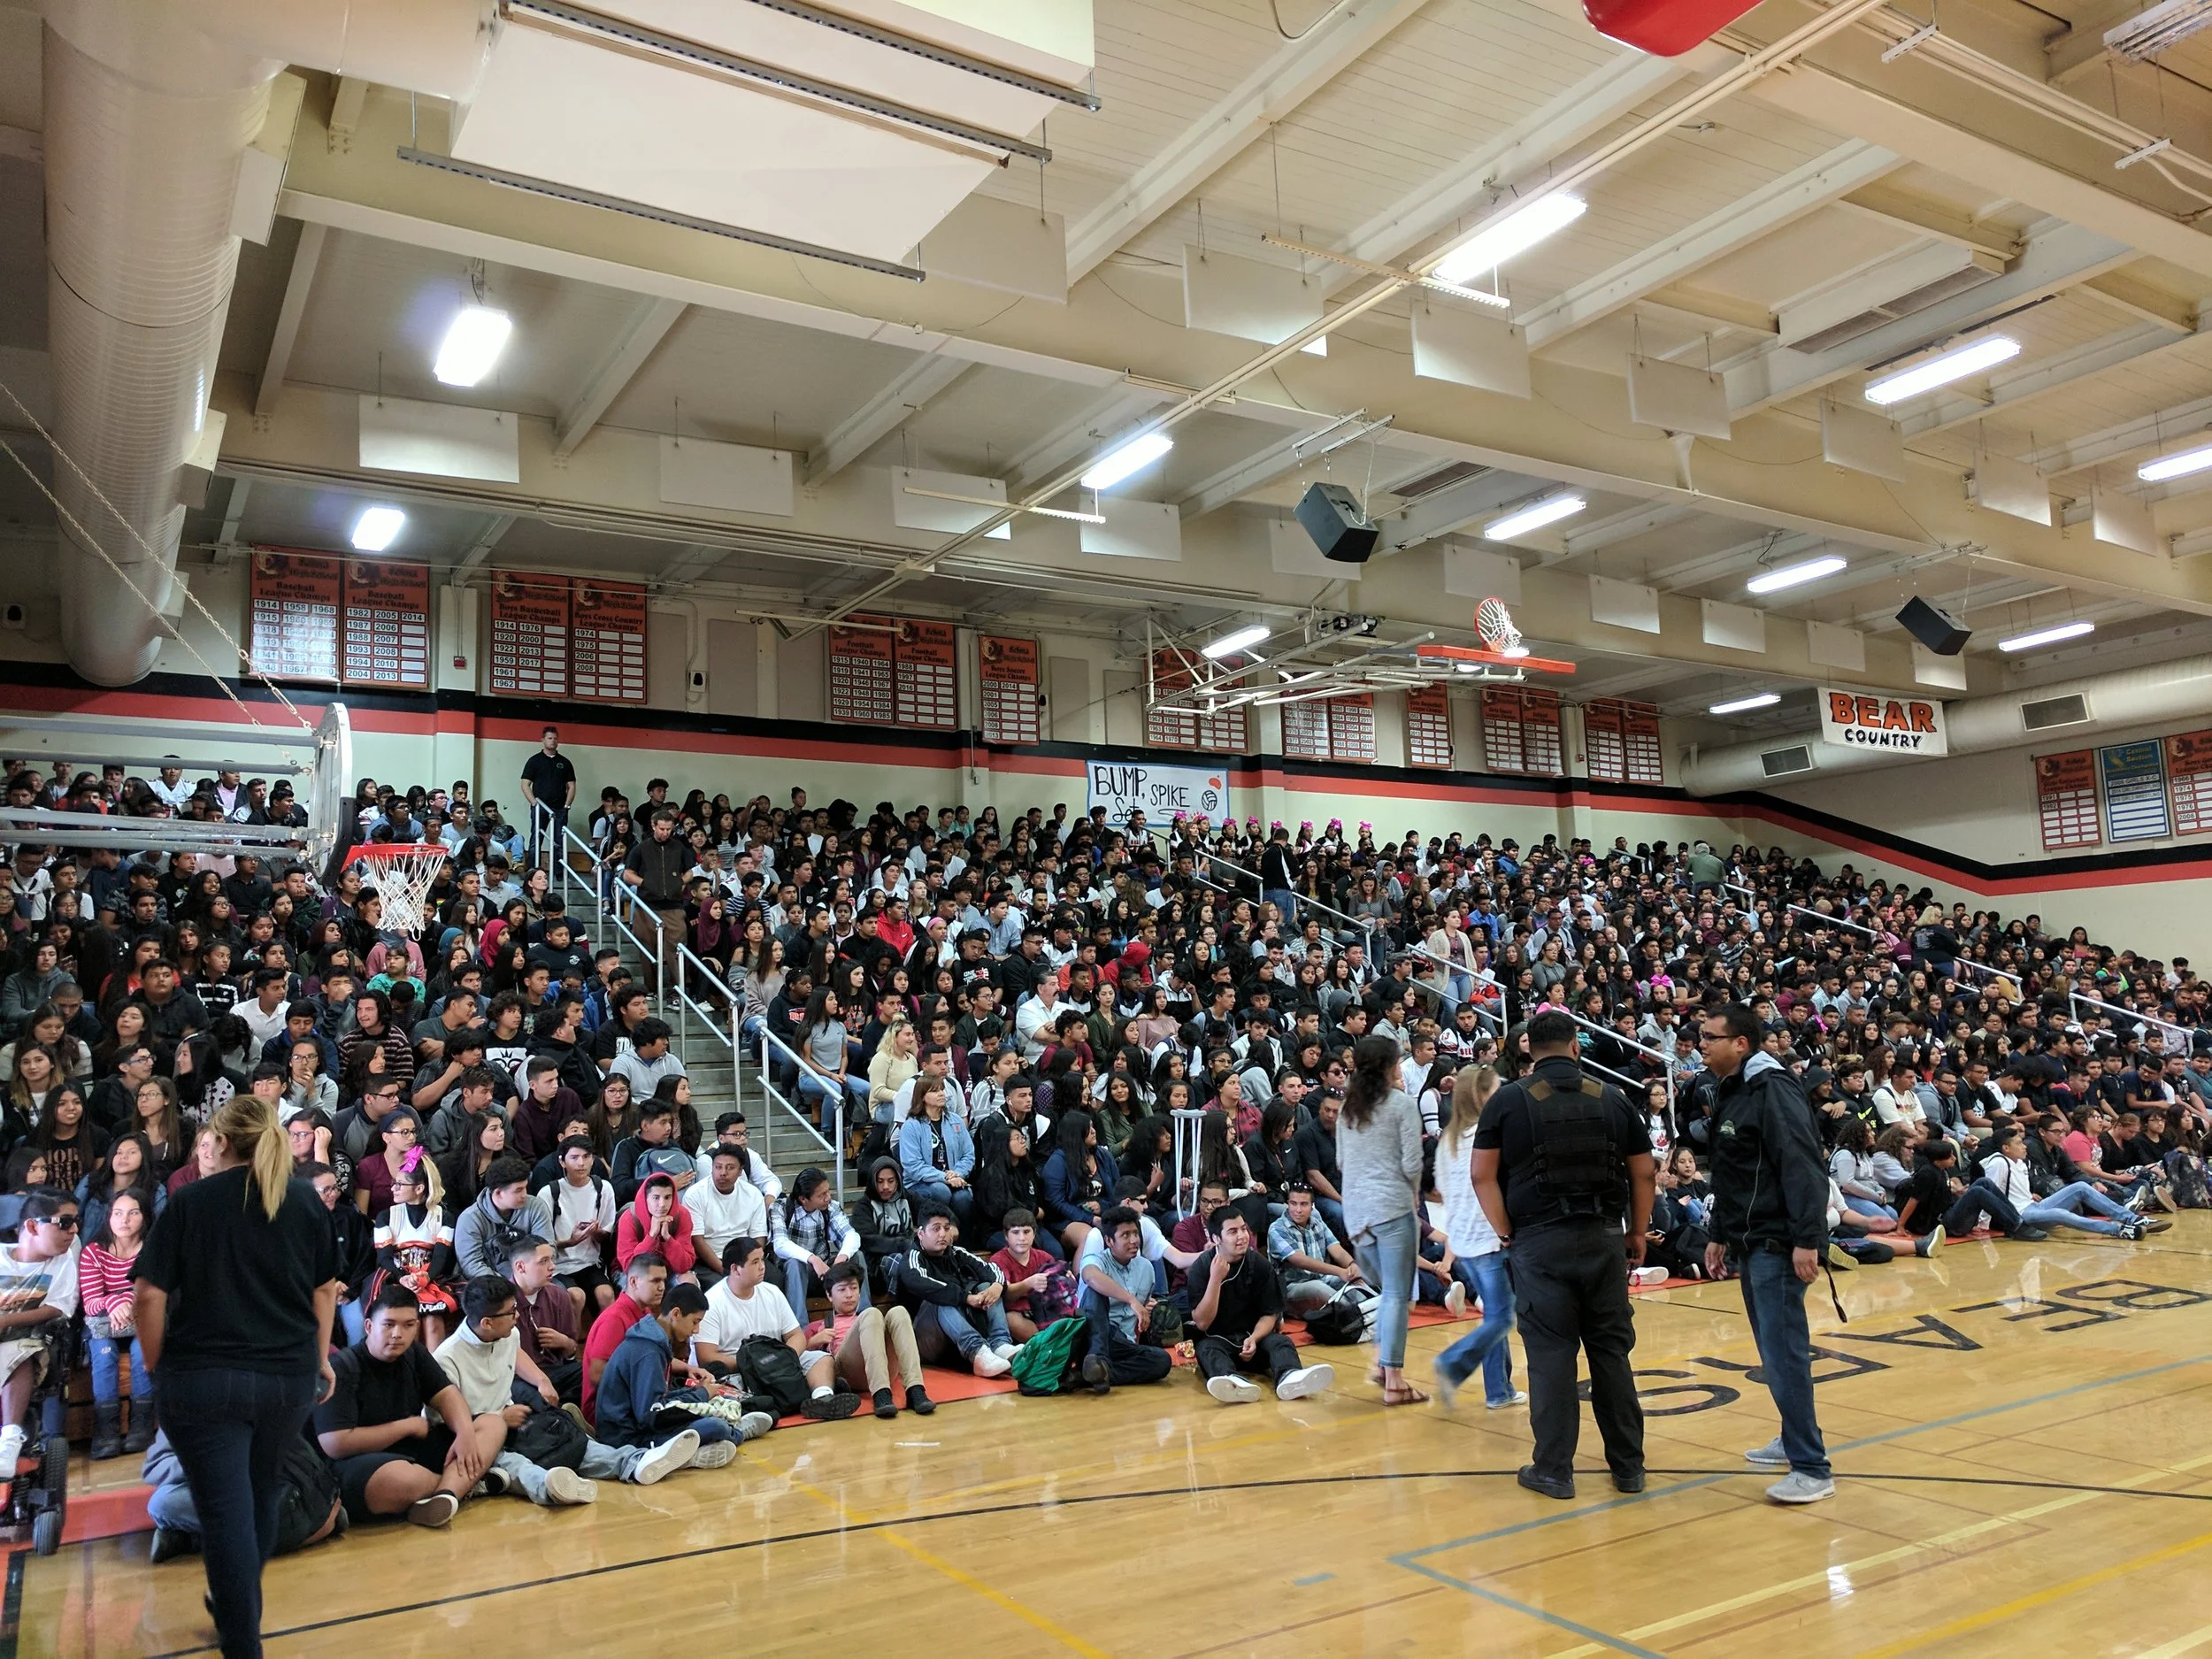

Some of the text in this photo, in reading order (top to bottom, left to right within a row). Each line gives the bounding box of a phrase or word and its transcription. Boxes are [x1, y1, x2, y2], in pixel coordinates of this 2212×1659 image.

[276, 581, 315, 591] Baseball
[259, 588, 292, 598] League
[500, 603, 561, 616] Boys Basketball
[500, 611, 527, 619] League
[580, 619, 607, 628] League
[614, 616, 643, 625] Country
[1829, 692, 1937, 733] BEAR
[1844, 728, 1922, 749] COUNTRY
[1094, 766, 1148, 800] BUMP,
[1150, 784, 1190, 807] SPIKE
[1112, 797, 1140, 823] Set
